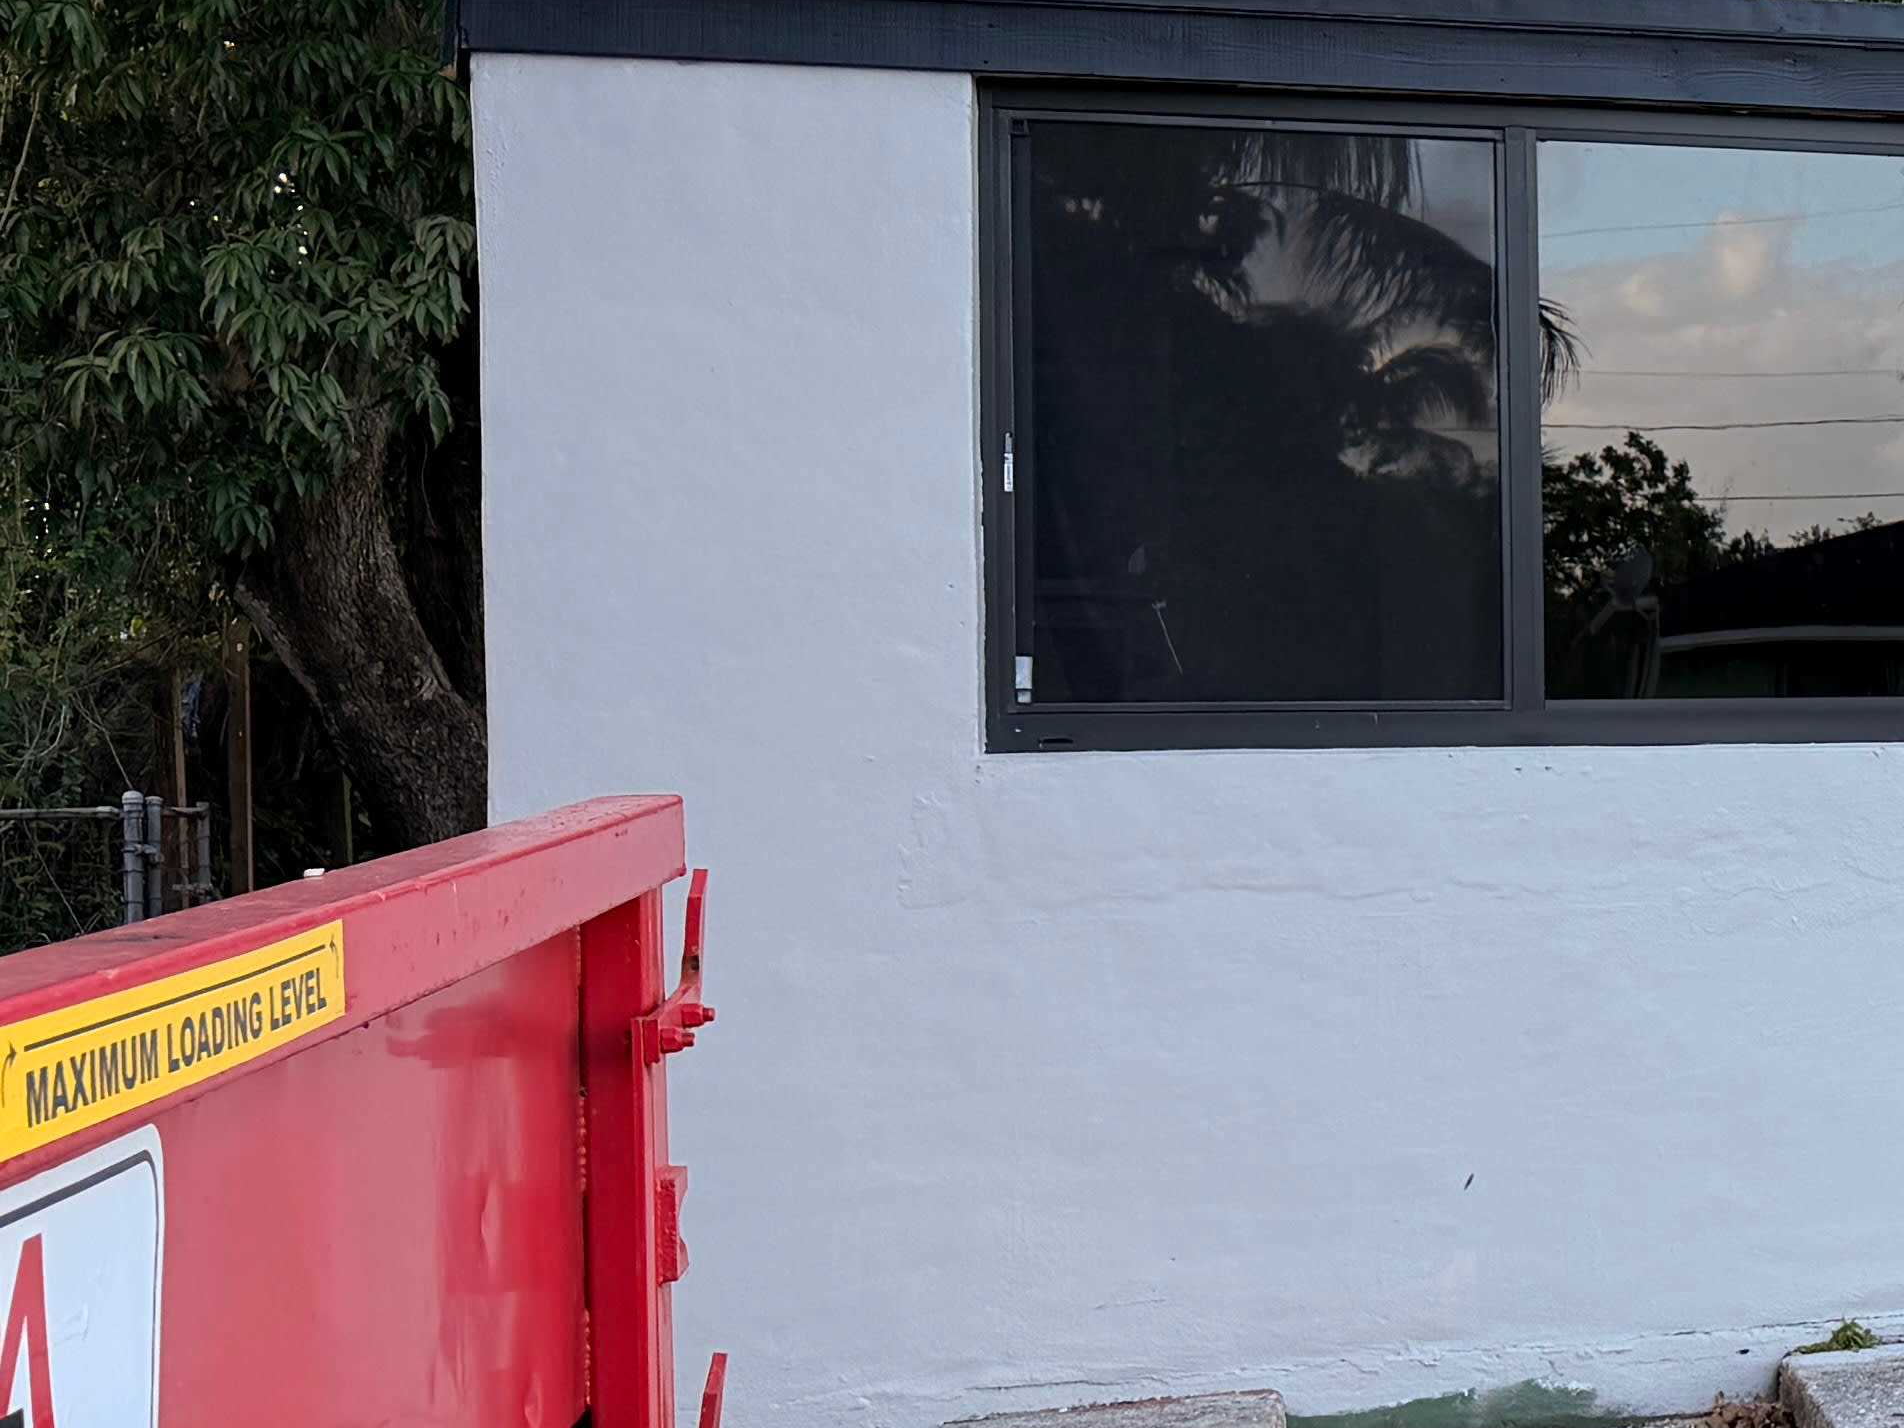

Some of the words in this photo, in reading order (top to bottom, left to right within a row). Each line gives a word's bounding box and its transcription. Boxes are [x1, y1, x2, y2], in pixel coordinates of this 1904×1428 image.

[26, 1028, 160, 1128] MAXIMUM
[166, 991, 264, 1074] LOADING
[269, 967, 328, 1031] LEVEL
